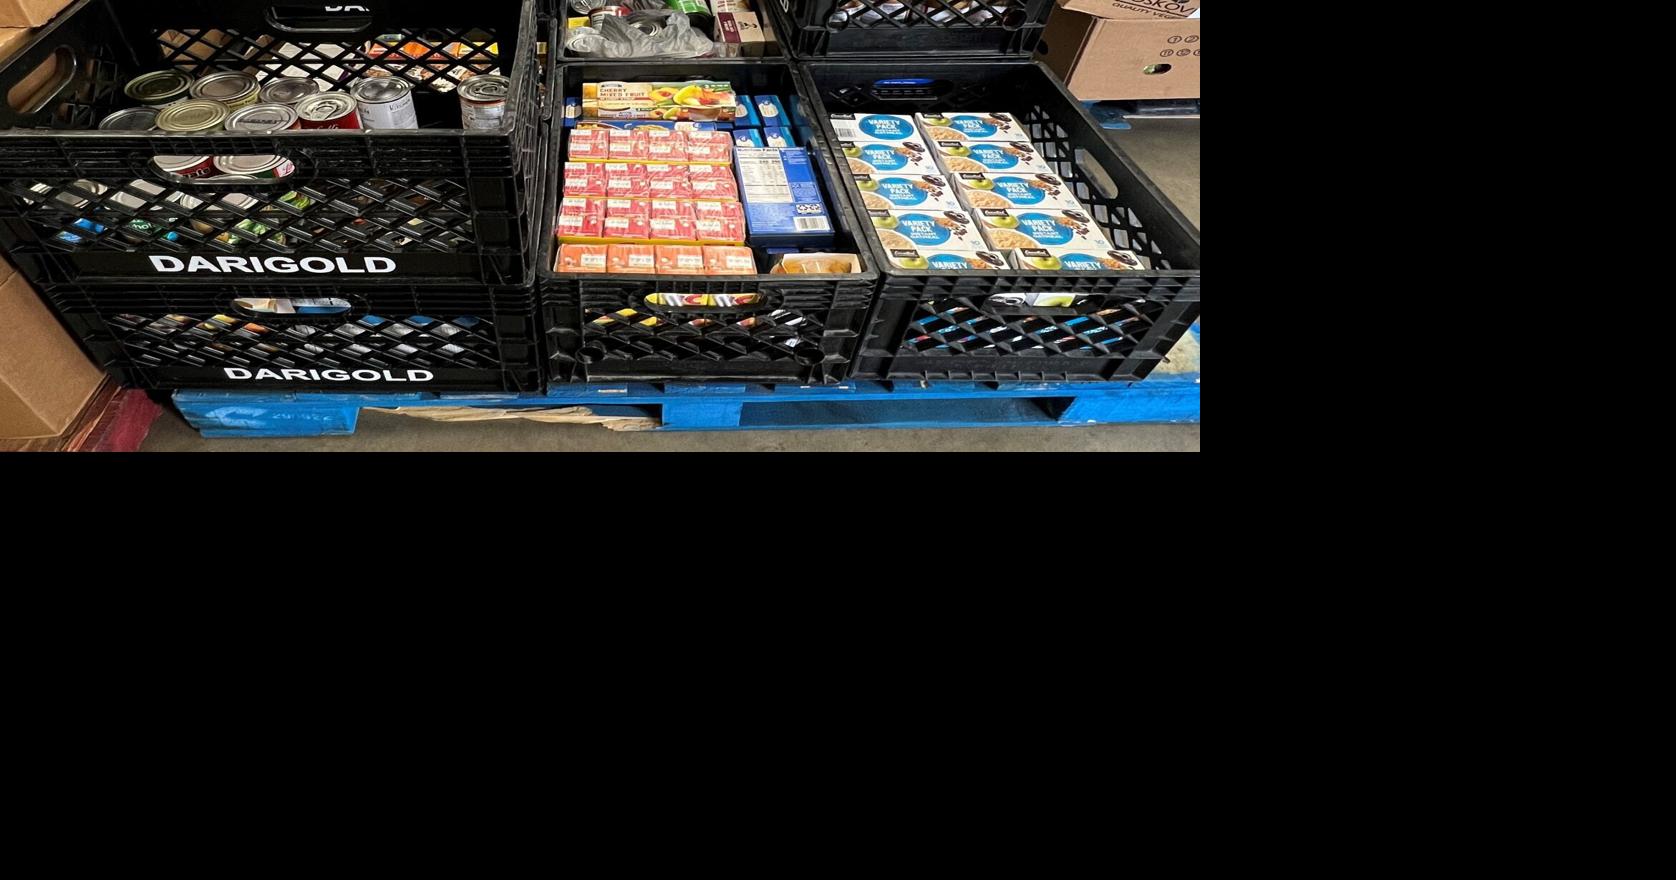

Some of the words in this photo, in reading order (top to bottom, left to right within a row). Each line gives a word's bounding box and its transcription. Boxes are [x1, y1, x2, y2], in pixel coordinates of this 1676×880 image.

[1112, 2, 1149, 13] QUALITY
[1131, 0, 1197, 13] SKOV
[149, 255, 397, 273] DARIGOLD
[931, 261, 967, 269] VARIETY
[1064, 260, 1101, 269] VARIETY
[223, 367, 434, 382] DARIGOLD
